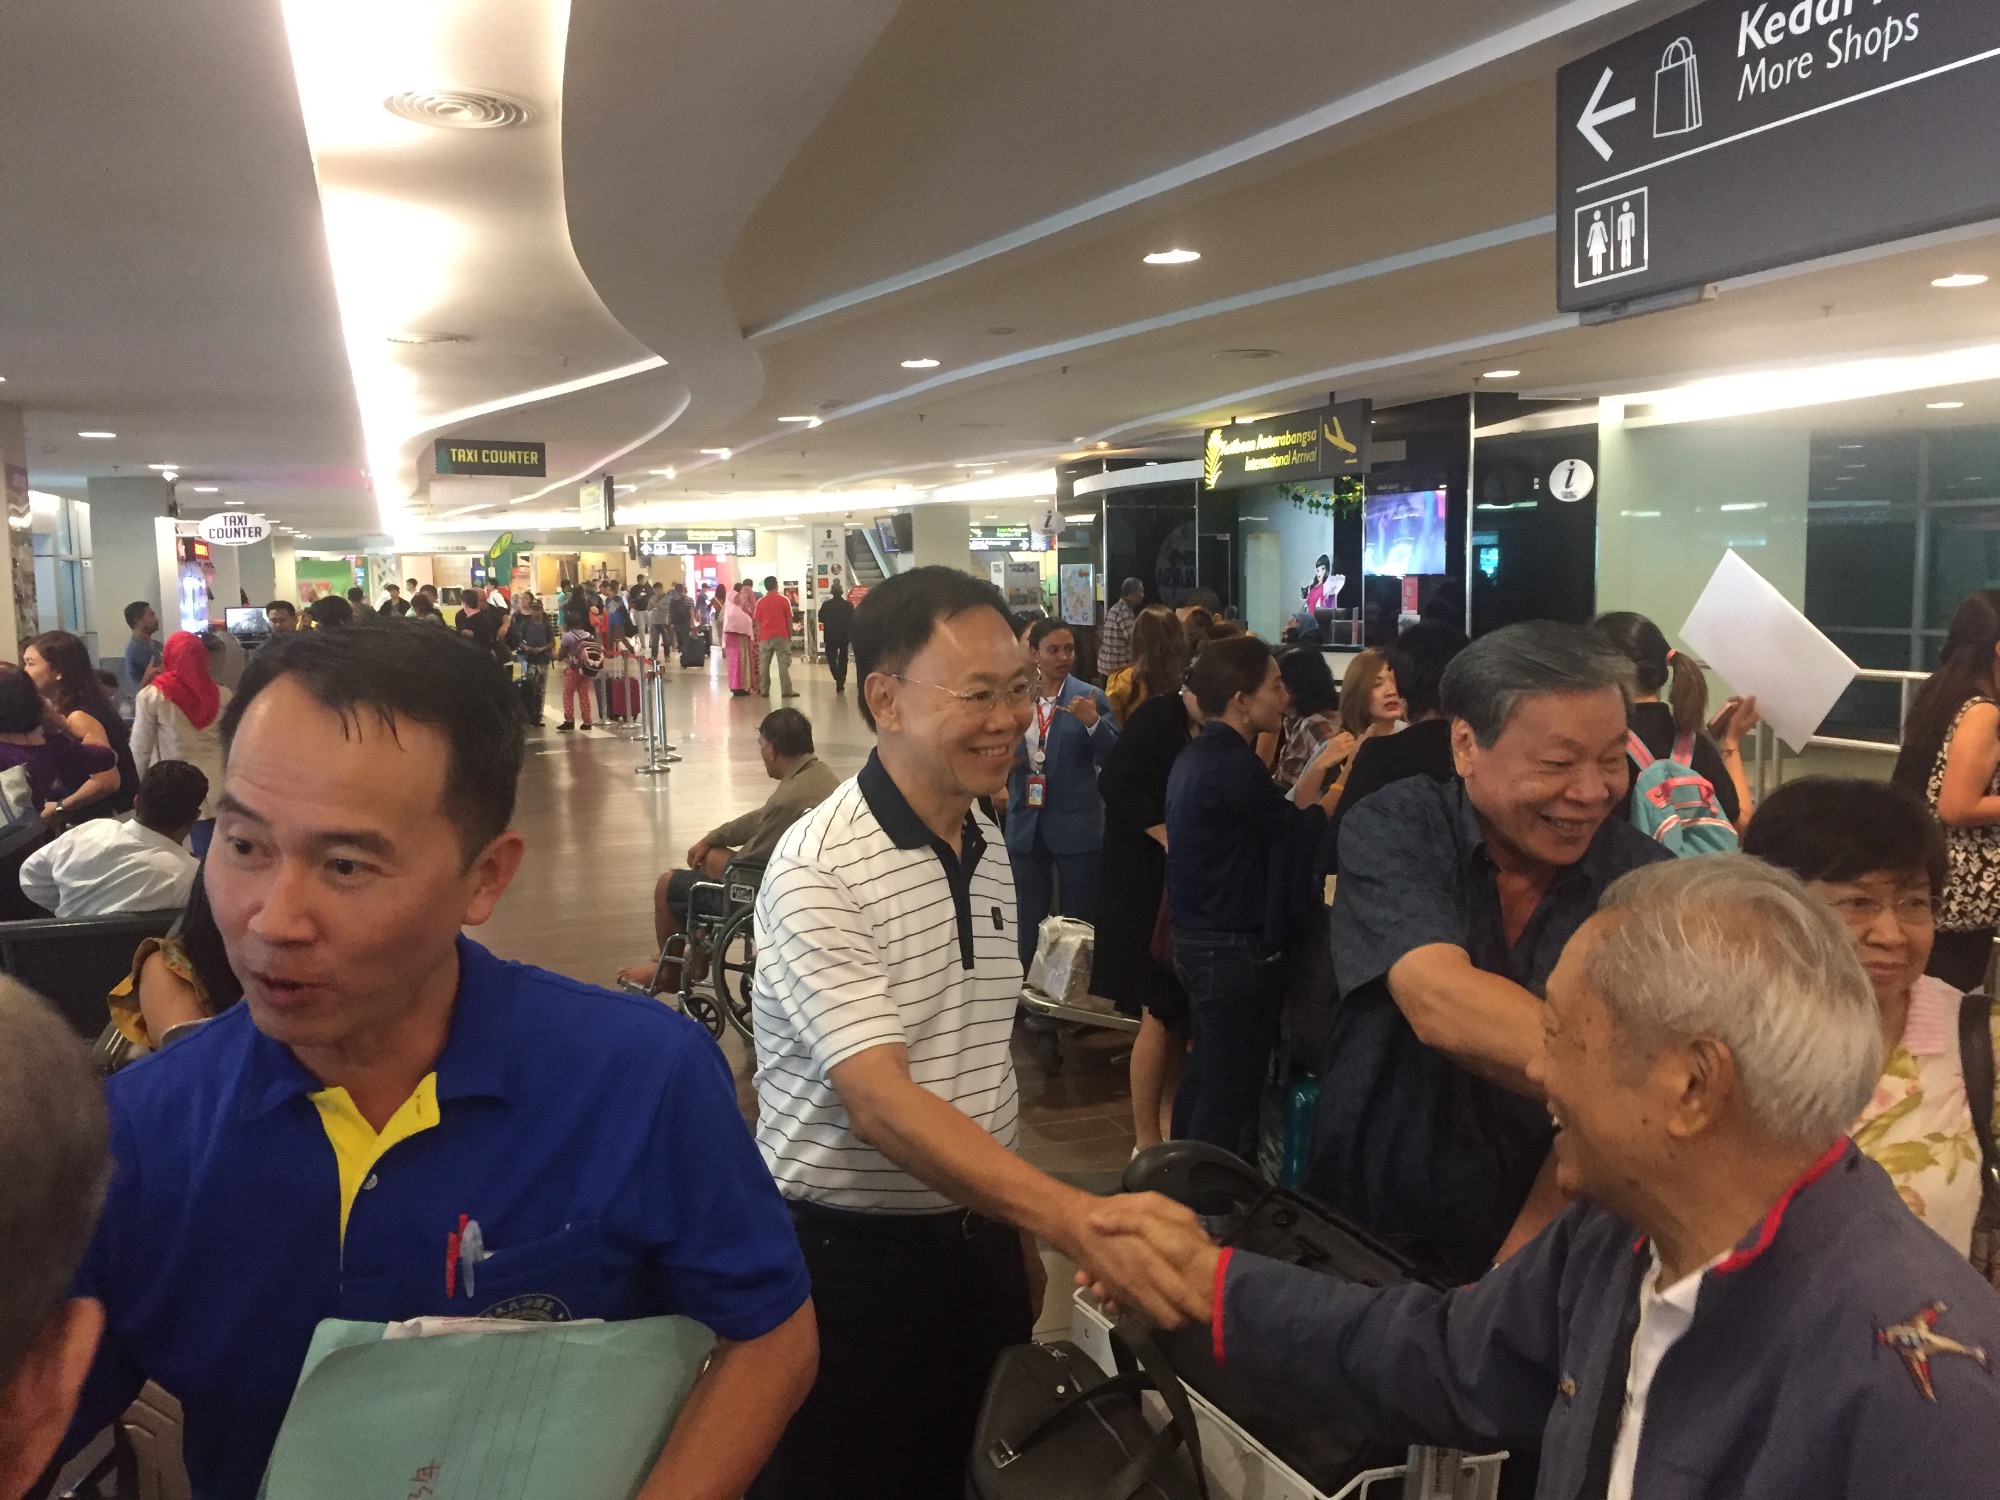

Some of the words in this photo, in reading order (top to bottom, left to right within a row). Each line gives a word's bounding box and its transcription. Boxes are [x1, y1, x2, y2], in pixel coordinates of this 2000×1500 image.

[1737, 52, 1813, 101] More
[1826, 12, 1920, 69] Shops
[450, 448, 478, 463] TAXI
[481, 449, 539, 465] COUNTER
[1291, 447, 1317, 465] Arrival
[222, 514, 248, 527] TAXI
[209, 526, 262, 539] COUNTER
